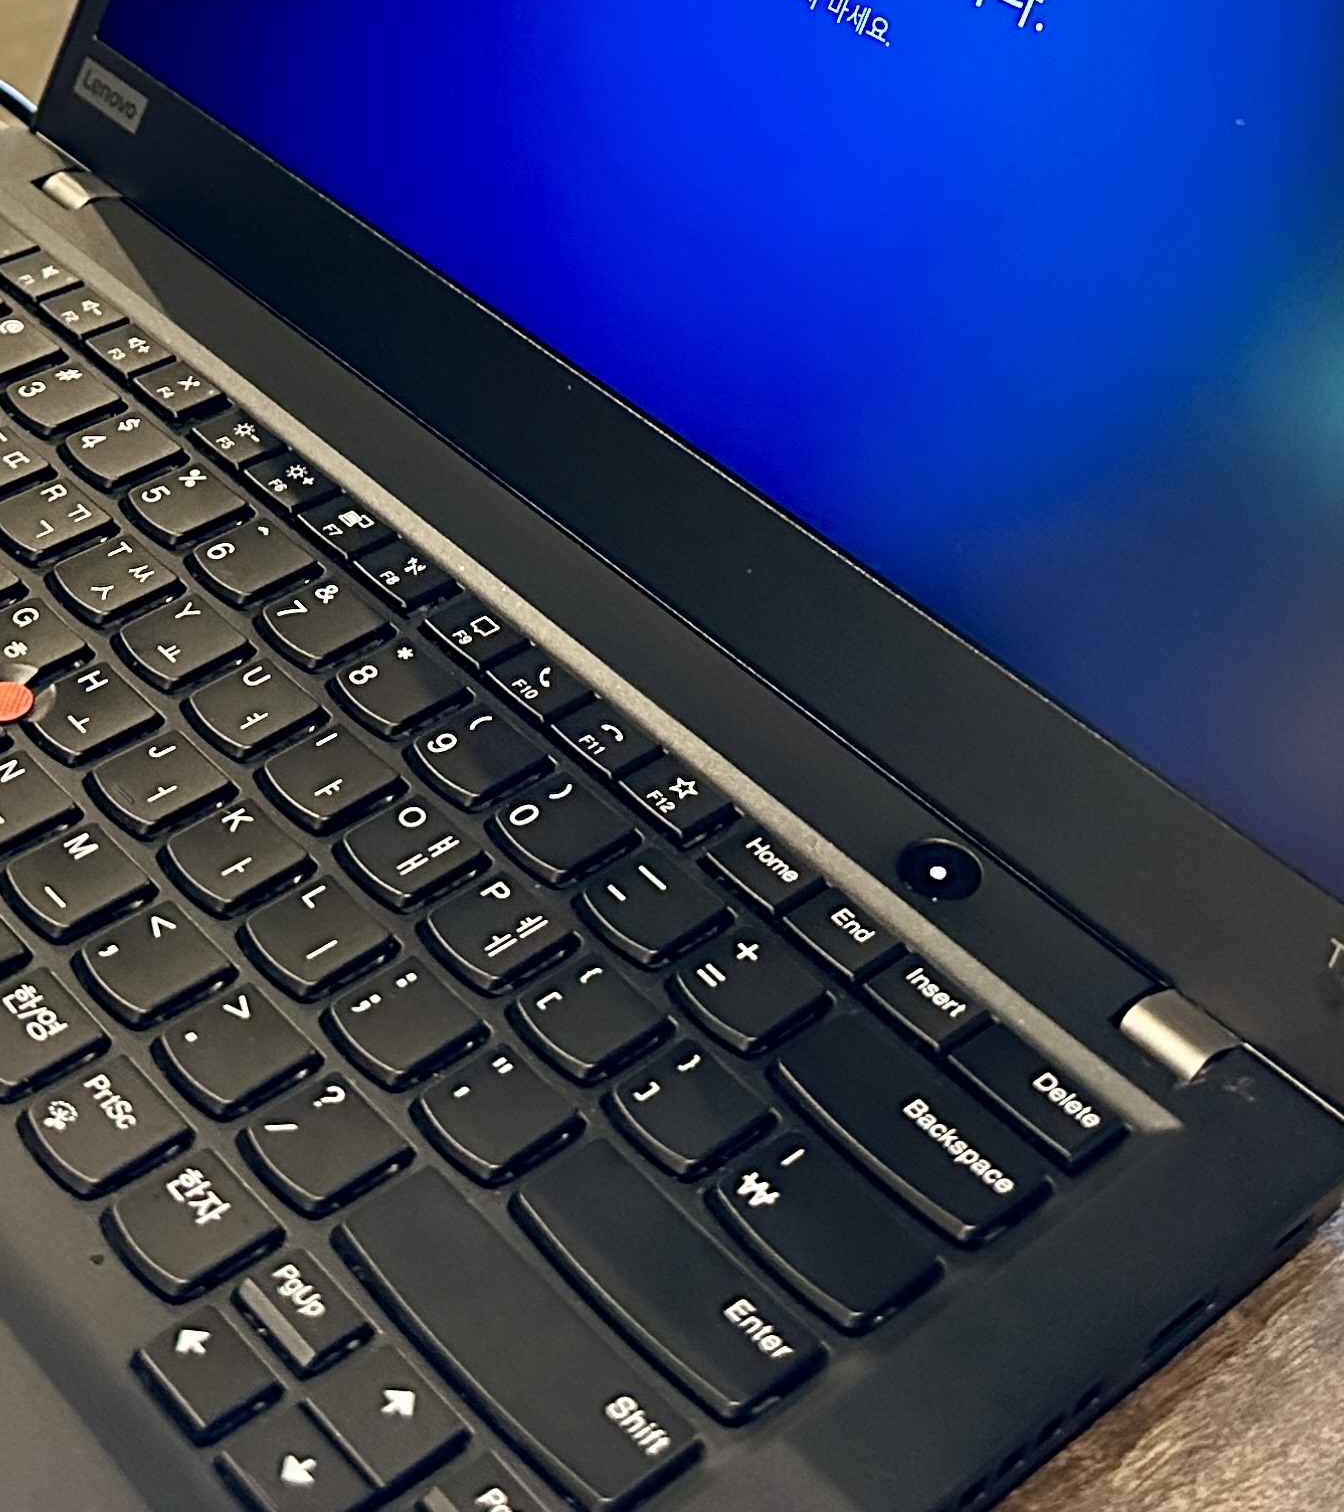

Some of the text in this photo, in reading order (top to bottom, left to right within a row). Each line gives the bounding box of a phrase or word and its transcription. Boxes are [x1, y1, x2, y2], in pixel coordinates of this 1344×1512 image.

[82, 69, 137, 120] Lenovo
[0, 320, 24, 333] @
[55, 370, 82, 380] #
[19, 382, 46, 397] 3
[157, 387, 174, 398] F4
[118, 419, 140, 431] $
[82, 436, 106, 448] 4
[216, 437, 235, 450] F5
[179, 469, 206, 487] %
[267, 479, 287, 493] F6
[41, 484, 67, 502] R
[142, 486, 170, 502] 5
[321, 522, 344, 538] F7
[107, 539, 132, 556] T
[207, 543, 235, 559] 6
[378, 570, 400, 587] F8
[315, 585, 338, 603] &
[13, 608, 39, 627] G
[175, 602, 201, 618] Y
[277, 600, 307, 616] 7
[451, 628, 473, 647] F9
[76, 669, 108, 692] H
[243, 666, 271, 686] U
[349, 665, 377, 684] 8
[510, 676, 542, 703] F10
[470, 716, 492, 730] (
[149, 746, 176, 757] J
[428, 733, 457, 752] 9
[576, 735, 605, 758] F11
[549, 784, 572, 799] )
[645, 789, 677, 815] F12
[222, 808, 254, 832] K
[399, 807, 426, 827] O
[510, 804, 539, 825] 0
[64, 833, 98, 859] M
[745, 837, 799, 885] Home
[302, 886, 325, 908] L
[480, 882, 510, 898] P
[151, 916, 176, 938] <
[831, 905, 879, 942] End
[737, 943, 758, 960] +
[580, 968, 602, 983] {
[697, 964, 725, 987] =
[537, 992, 562, 1009] [
[905, 967, 968, 1019] Insert
[3, 985, 67, 1041] 한/영
[223, 995, 250, 1018] >
[678, 1055, 700, 1071] }
[313, 1086, 345, 1107] ?
[634, 1082, 660, 1101] ]
[1032, 1072, 1102, 1129] Delete
[84, 1075, 136, 1129] PrtSc
[904, 1098, 1017, 1194] Backspace
[167, 1168, 231, 1225] 한자
[738, 1172, 779, 1206] ₩
[270, 1265, 325, 1320] PgUp
[724, 1299, 793, 1357] Enter
[606, 1397, 669, 1454] Shift
